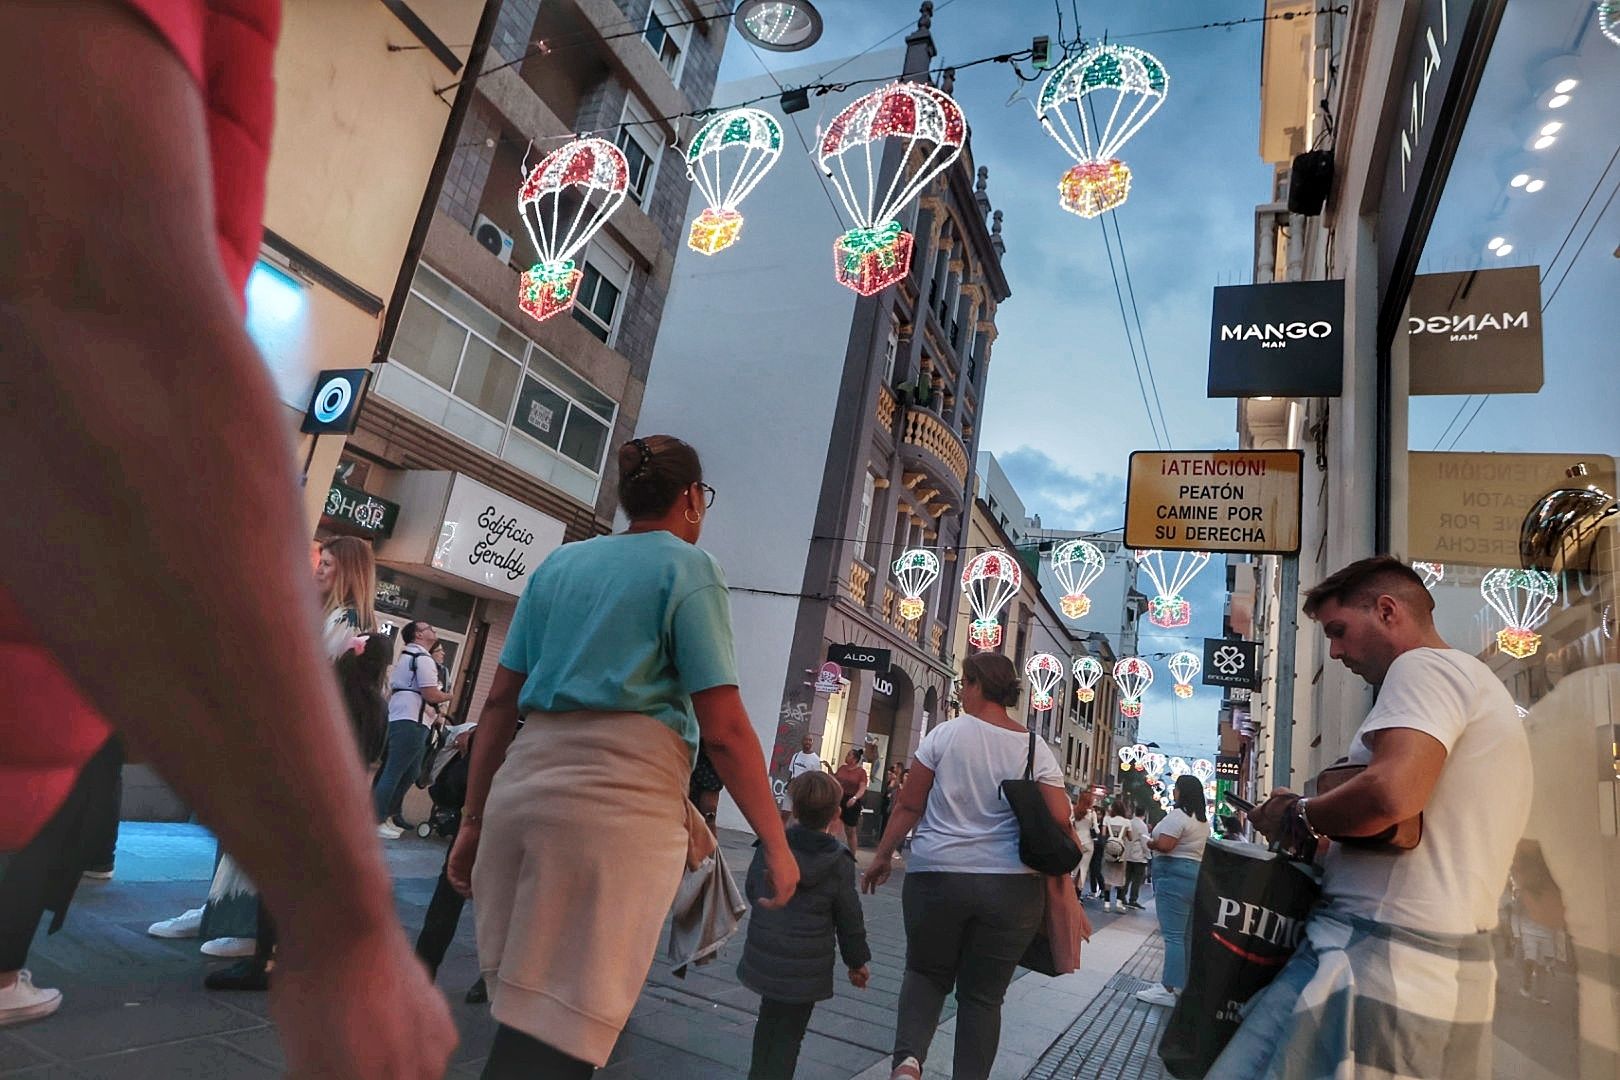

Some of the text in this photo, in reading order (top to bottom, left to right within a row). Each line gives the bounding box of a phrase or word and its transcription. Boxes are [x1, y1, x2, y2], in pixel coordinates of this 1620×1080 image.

[1221, 321, 1332, 341] MANGO
[1161, 457, 1267, 476] ¡ATENCIÓN!
[1179, 483, 1244, 500] PEATÓN
[1156, 505, 1263, 521] CAMINE POR
[477, 505, 534, 545] Edificio
[1155, 525, 1266, 542] SU DERECHA
[469, 540, 526, 580] Geraldy
[843, 653, 875, 662] ALDO
